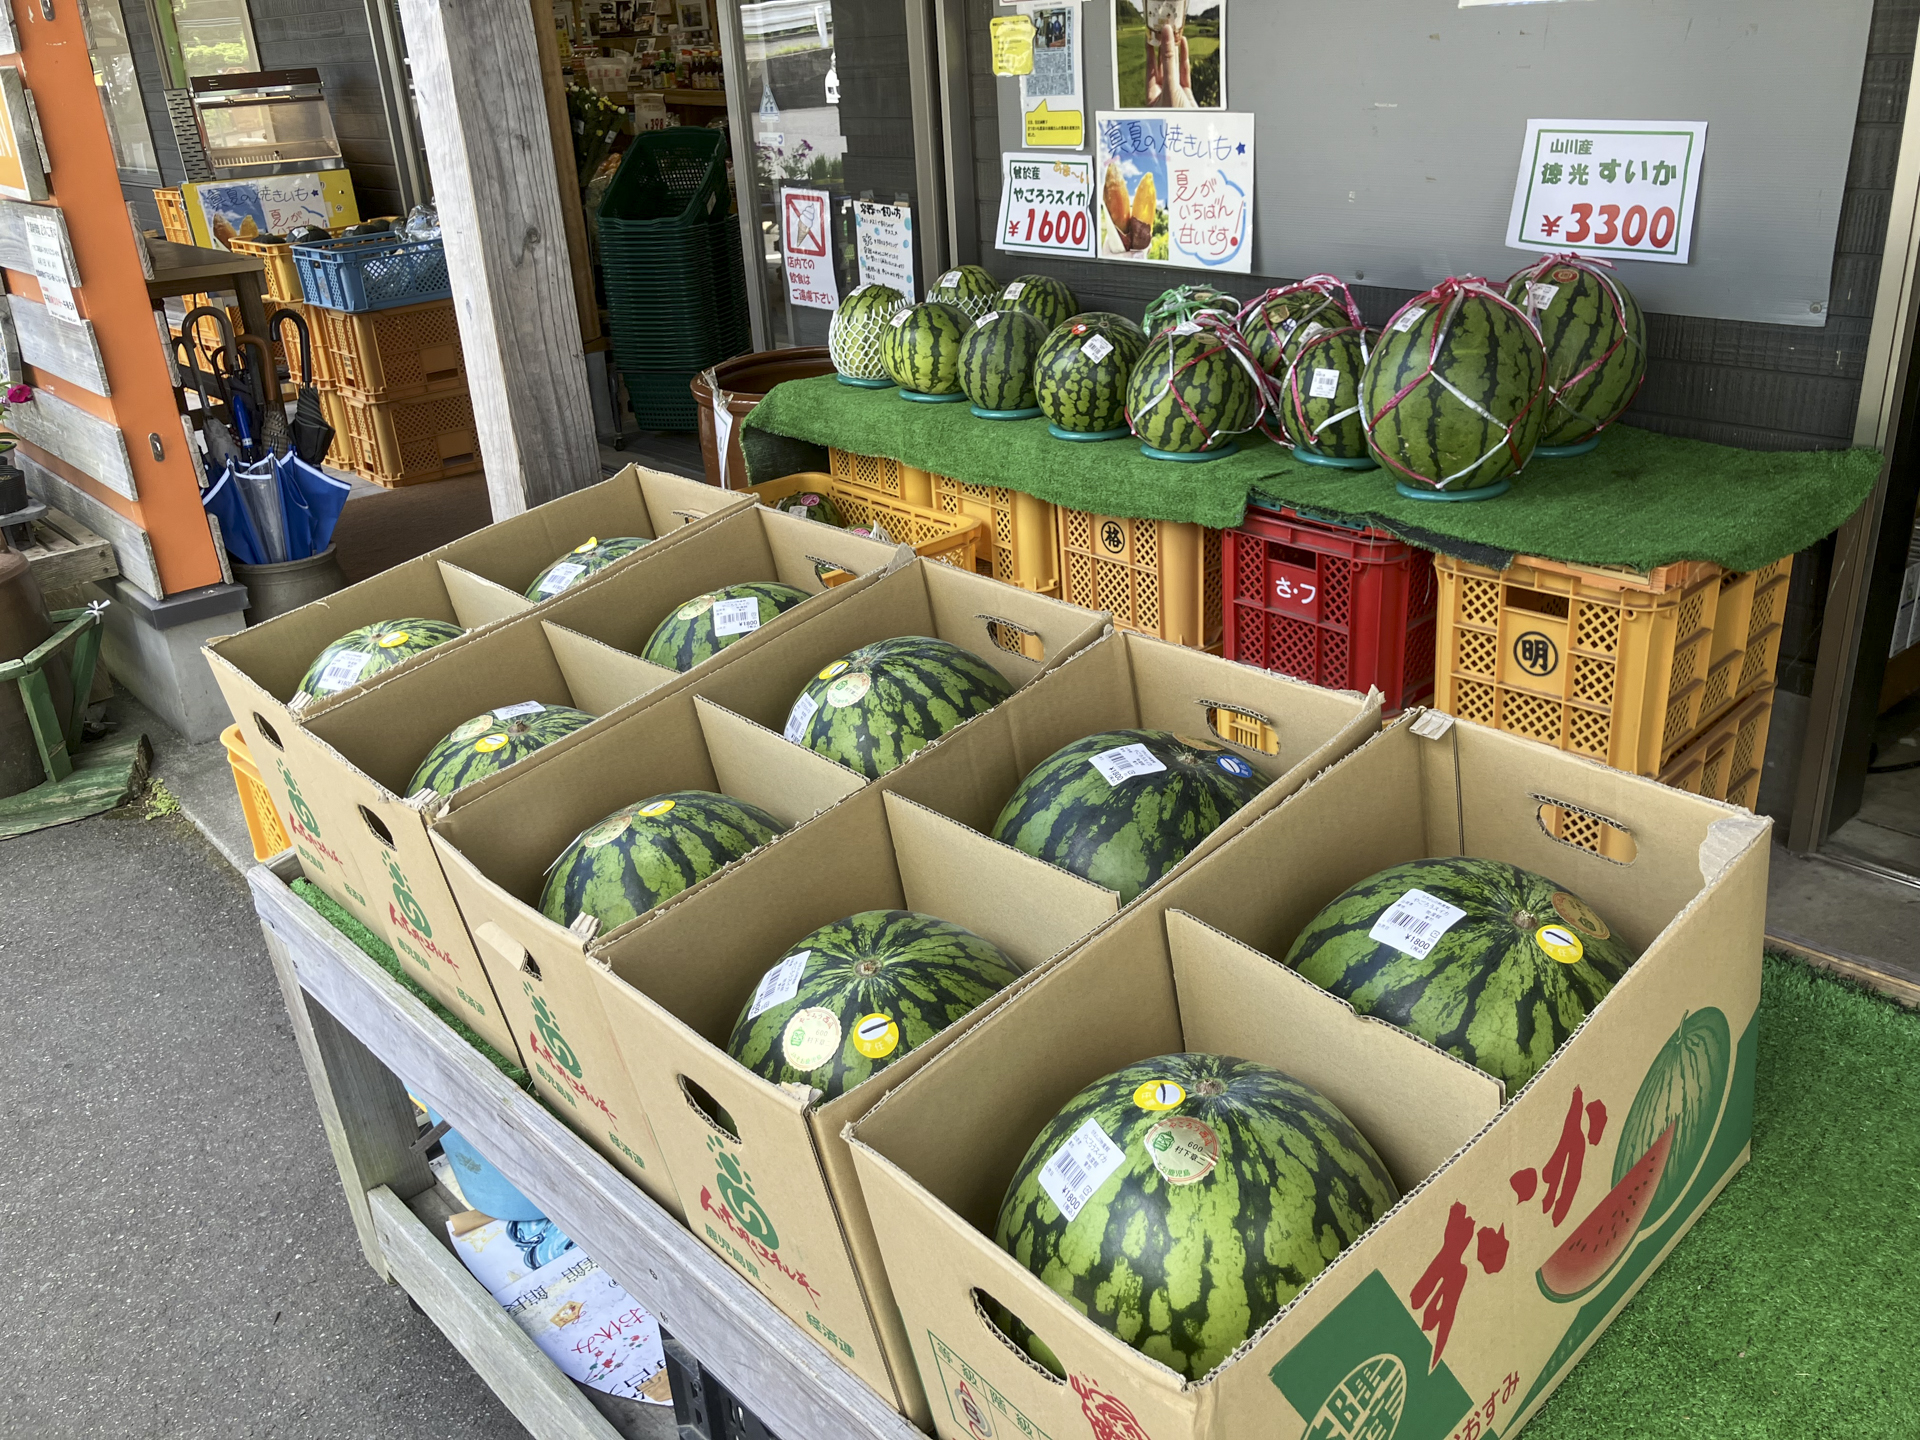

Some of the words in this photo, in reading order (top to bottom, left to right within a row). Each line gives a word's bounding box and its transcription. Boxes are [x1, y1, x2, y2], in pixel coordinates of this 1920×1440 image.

[1104, 120, 1233, 161] 真夏の焼きいも
[1550, 138, 1594, 155] 山川産
[1541, 158, 1677, 186] 徳光すいか
[1013, 187, 1086, 207] やごろうスイカ
[1174, 169, 1218, 204] 夏が
[1179, 195, 1234, 221] いちばん
[1008, 208, 1087, 246] ¥1600
[1540, 202, 1676, 249] ¥3300
[787, 256, 816, 270] 店内での
[789, 271, 811, 285] 飲食は
[792, 288, 834, 305] ご遠慮下さい
[1521, 639, 1549, 672] 明
[1404, 933, 1431, 951] ¥1800
[815, 1029, 829, 1037] 600
[1187, 1141, 1204, 1153] 600
[1062, 1184, 1081, 1210] ¥1800
[1409, 1083, 1608, 1377] すいか
[705, 1222, 761, 1281] 鹿児島県
[805, 1310, 856, 1359] 経済連
[961, 1396, 982, 1424] B
